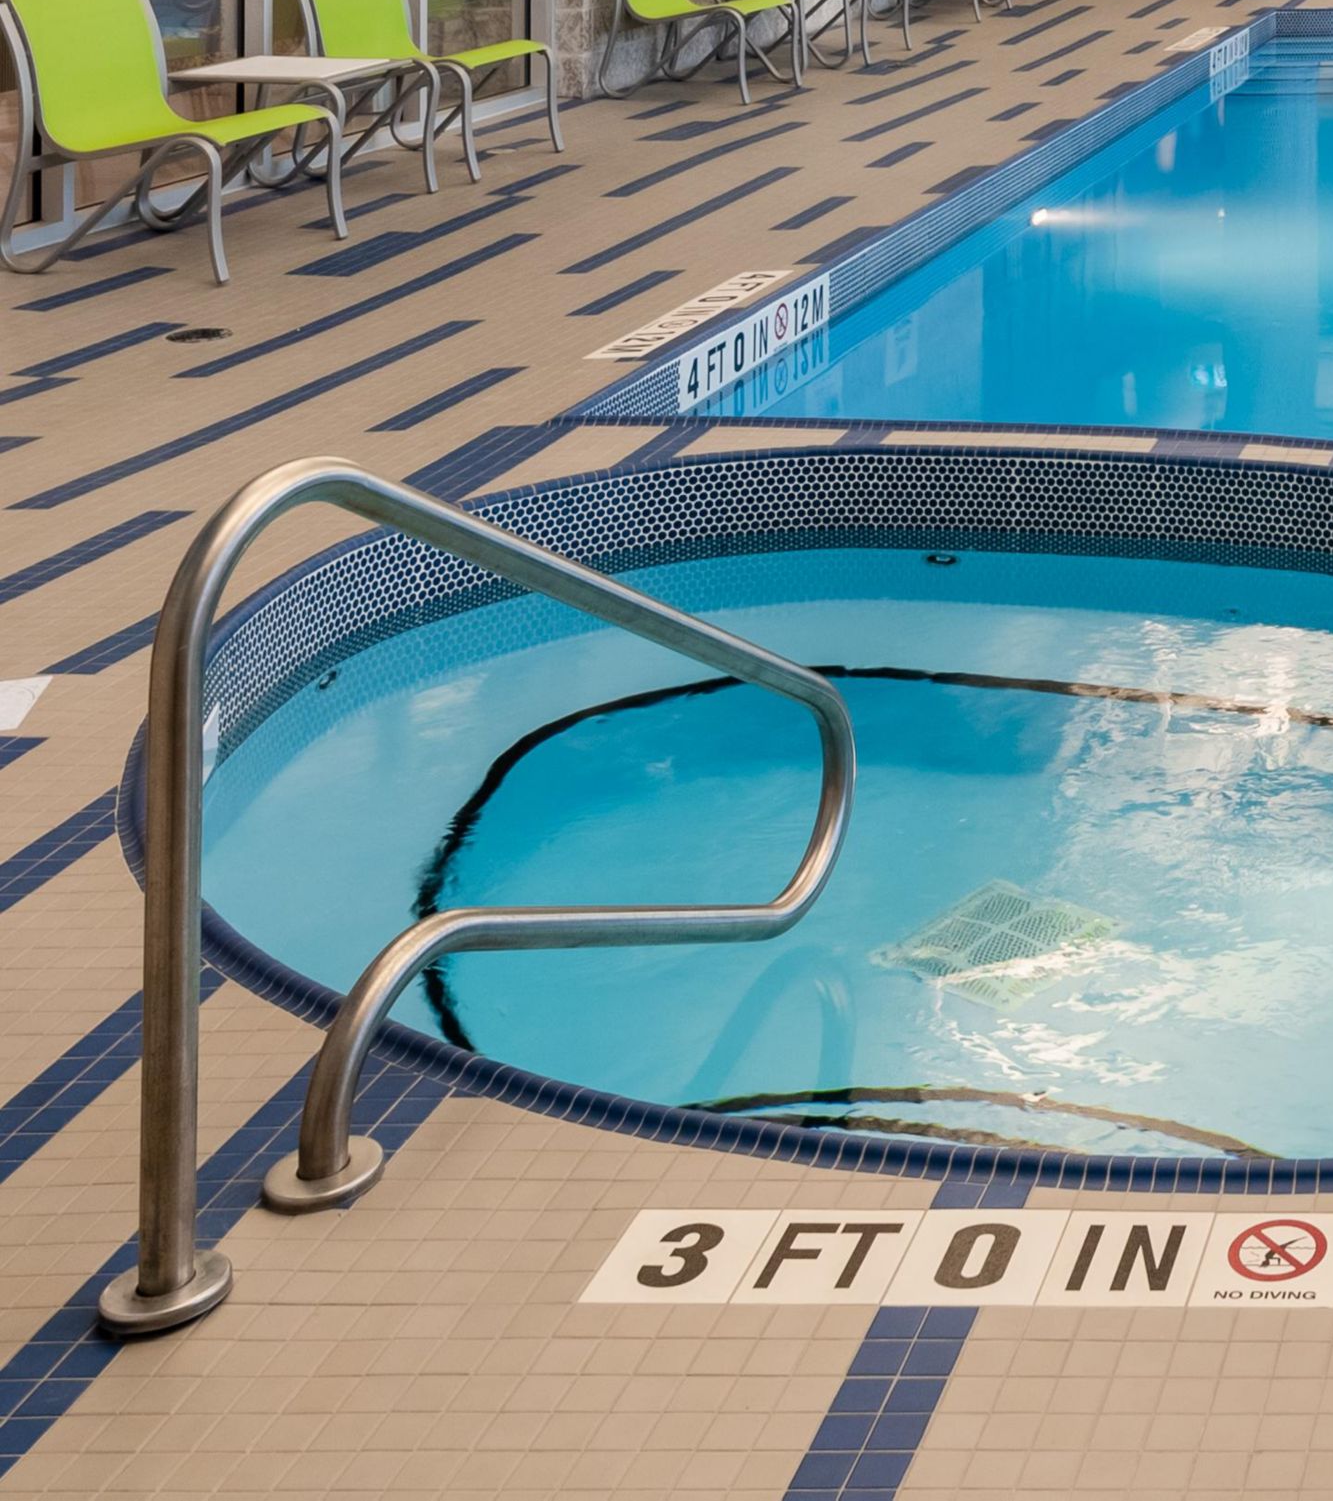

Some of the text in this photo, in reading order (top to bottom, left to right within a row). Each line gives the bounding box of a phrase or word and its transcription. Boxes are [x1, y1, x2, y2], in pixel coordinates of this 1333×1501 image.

[717, 282, 762, 292] FT
[688, 358, 699, 399] 4
[707, 341, 726, 391] FT
[753, 316, 768, 362] IN
[636, 1222, 725, 1288] 3
[752, 1222, 905, 1289] FT
[1064, 1224, 1187, 1292] IN
[1213, 1291, 1317, 1300] NO DIVING
